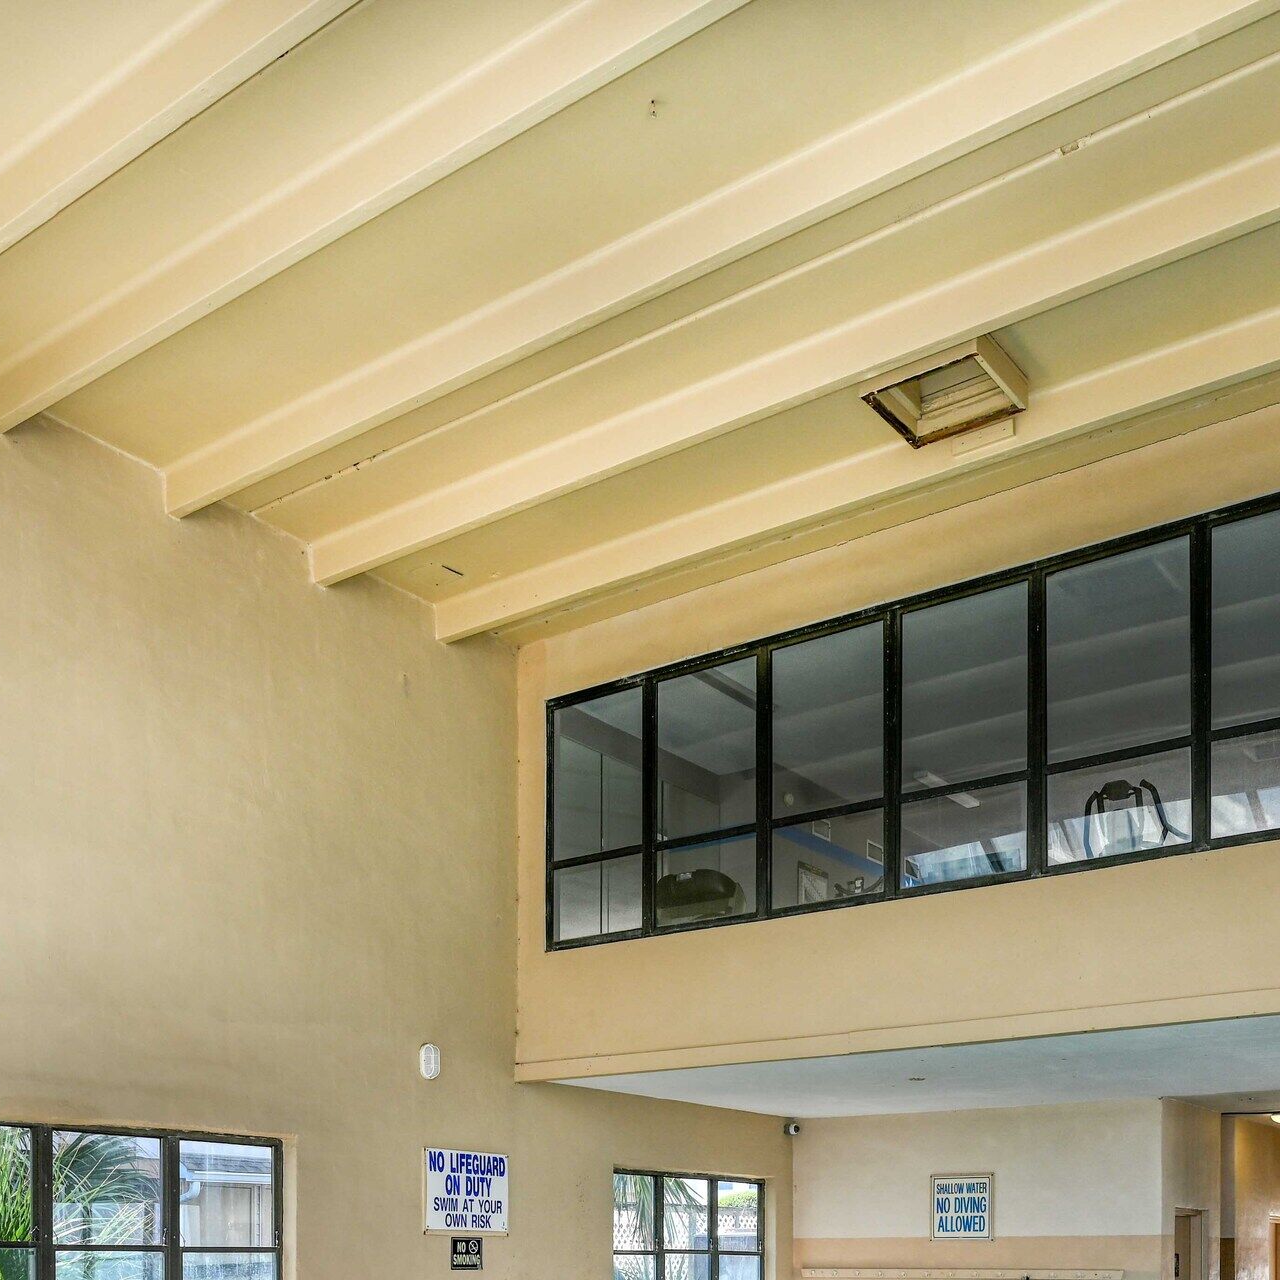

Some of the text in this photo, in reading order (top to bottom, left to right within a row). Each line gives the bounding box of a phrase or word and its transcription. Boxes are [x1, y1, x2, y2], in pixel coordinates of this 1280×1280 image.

[429, 1151, 505, 1176] NO LIFEGUARD
[446, 1174, 492, 1197] ON DUTY
[936, 1182, 987, 1194] SHALLOW WATER
[434, 1197, 502, 1214] SWIM AT YOUR
[936, 1197, 986, 1213] NO DIVING
[445, 1213, 491, 1228] OWN RISK
[938, 1216, 985, 1232] ALLOWED
[457, 1242, 466, 1252] NO
[453, 1254, 480, 1265] SMOKING
